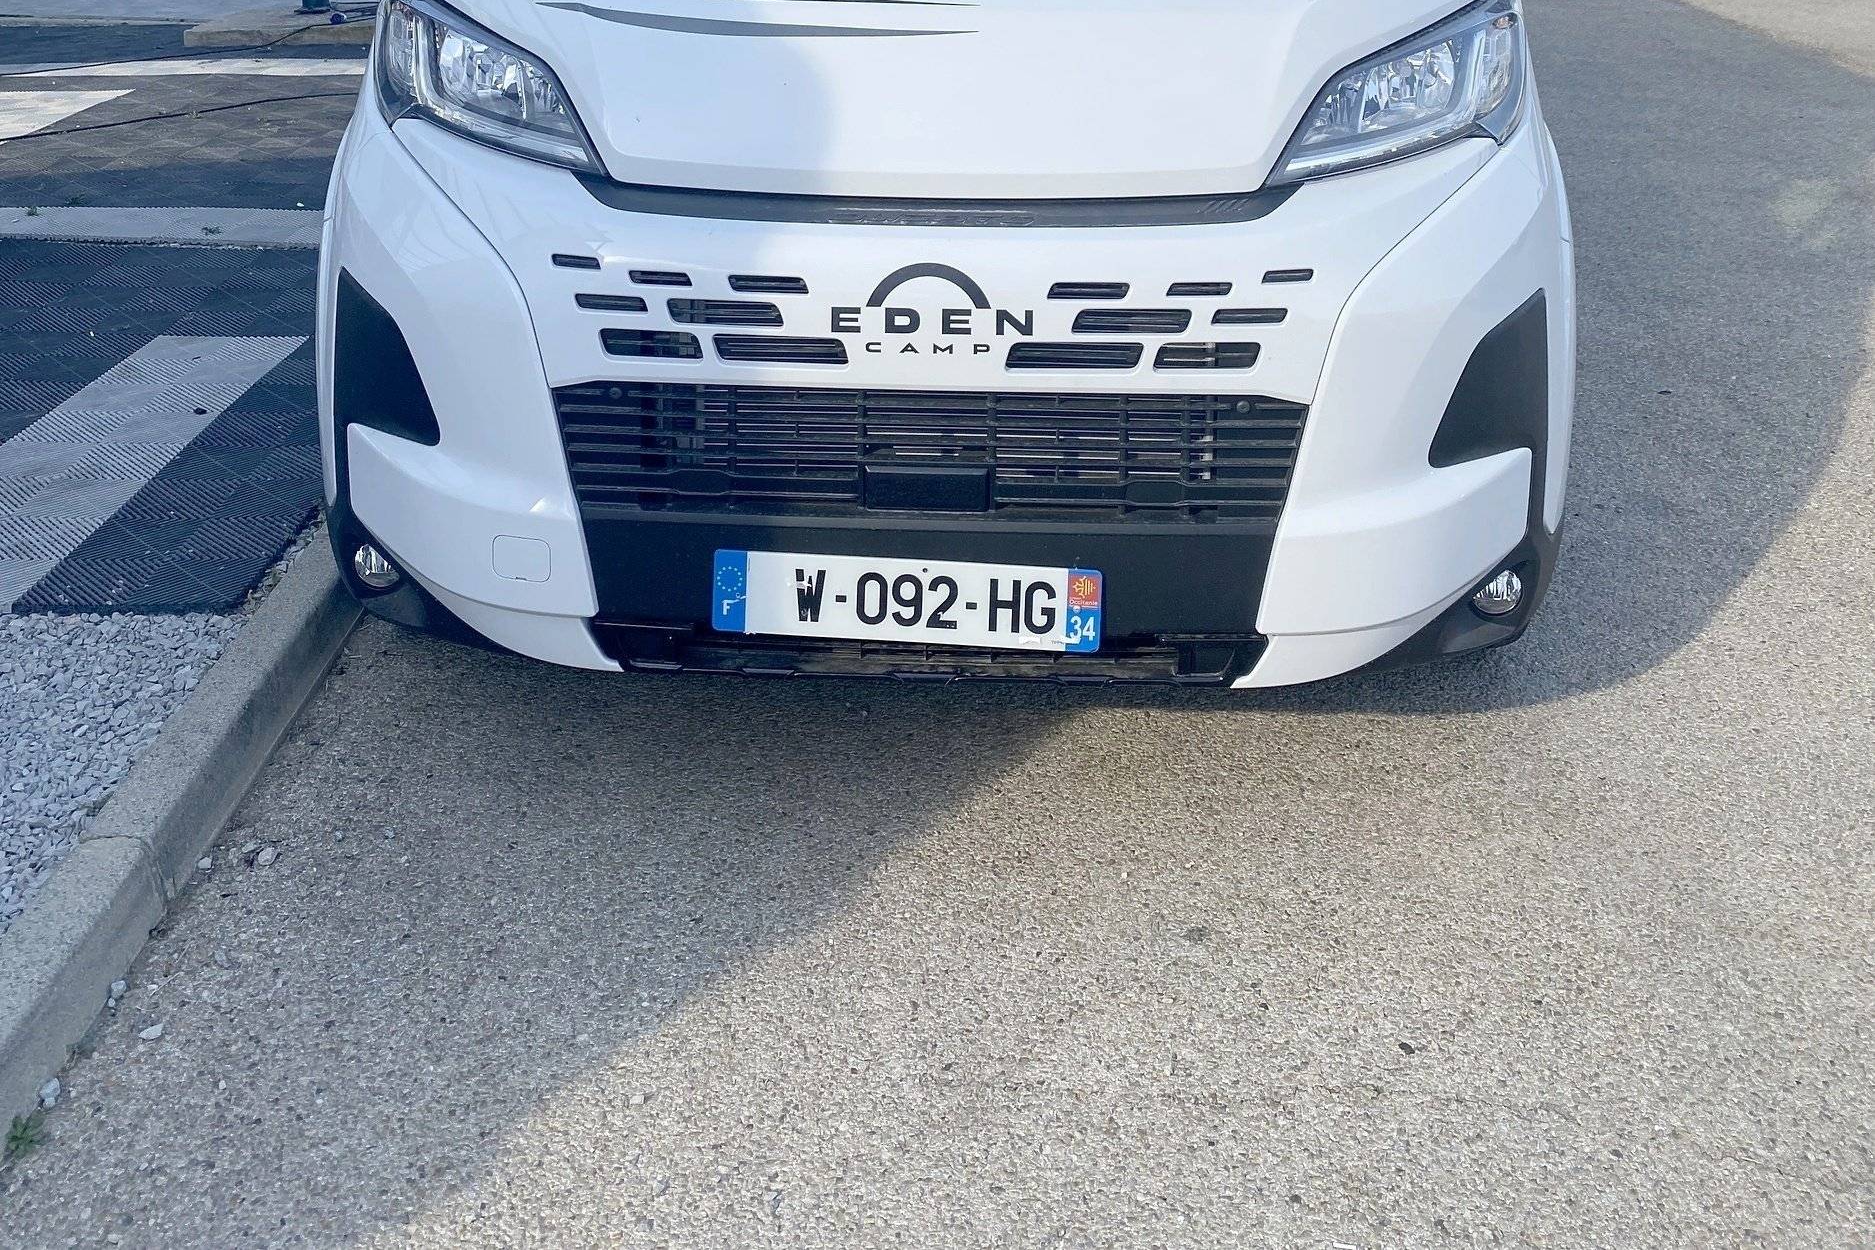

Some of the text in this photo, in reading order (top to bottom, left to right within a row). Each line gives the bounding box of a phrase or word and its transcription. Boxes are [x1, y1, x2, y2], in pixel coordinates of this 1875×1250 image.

[831, 306, 1034, 336] EDEN
[865, 341, 991, 355] CAMP
[722, 568, 1057, 635] F W-092-HG
[1069, 615, 1096, 642] 34
